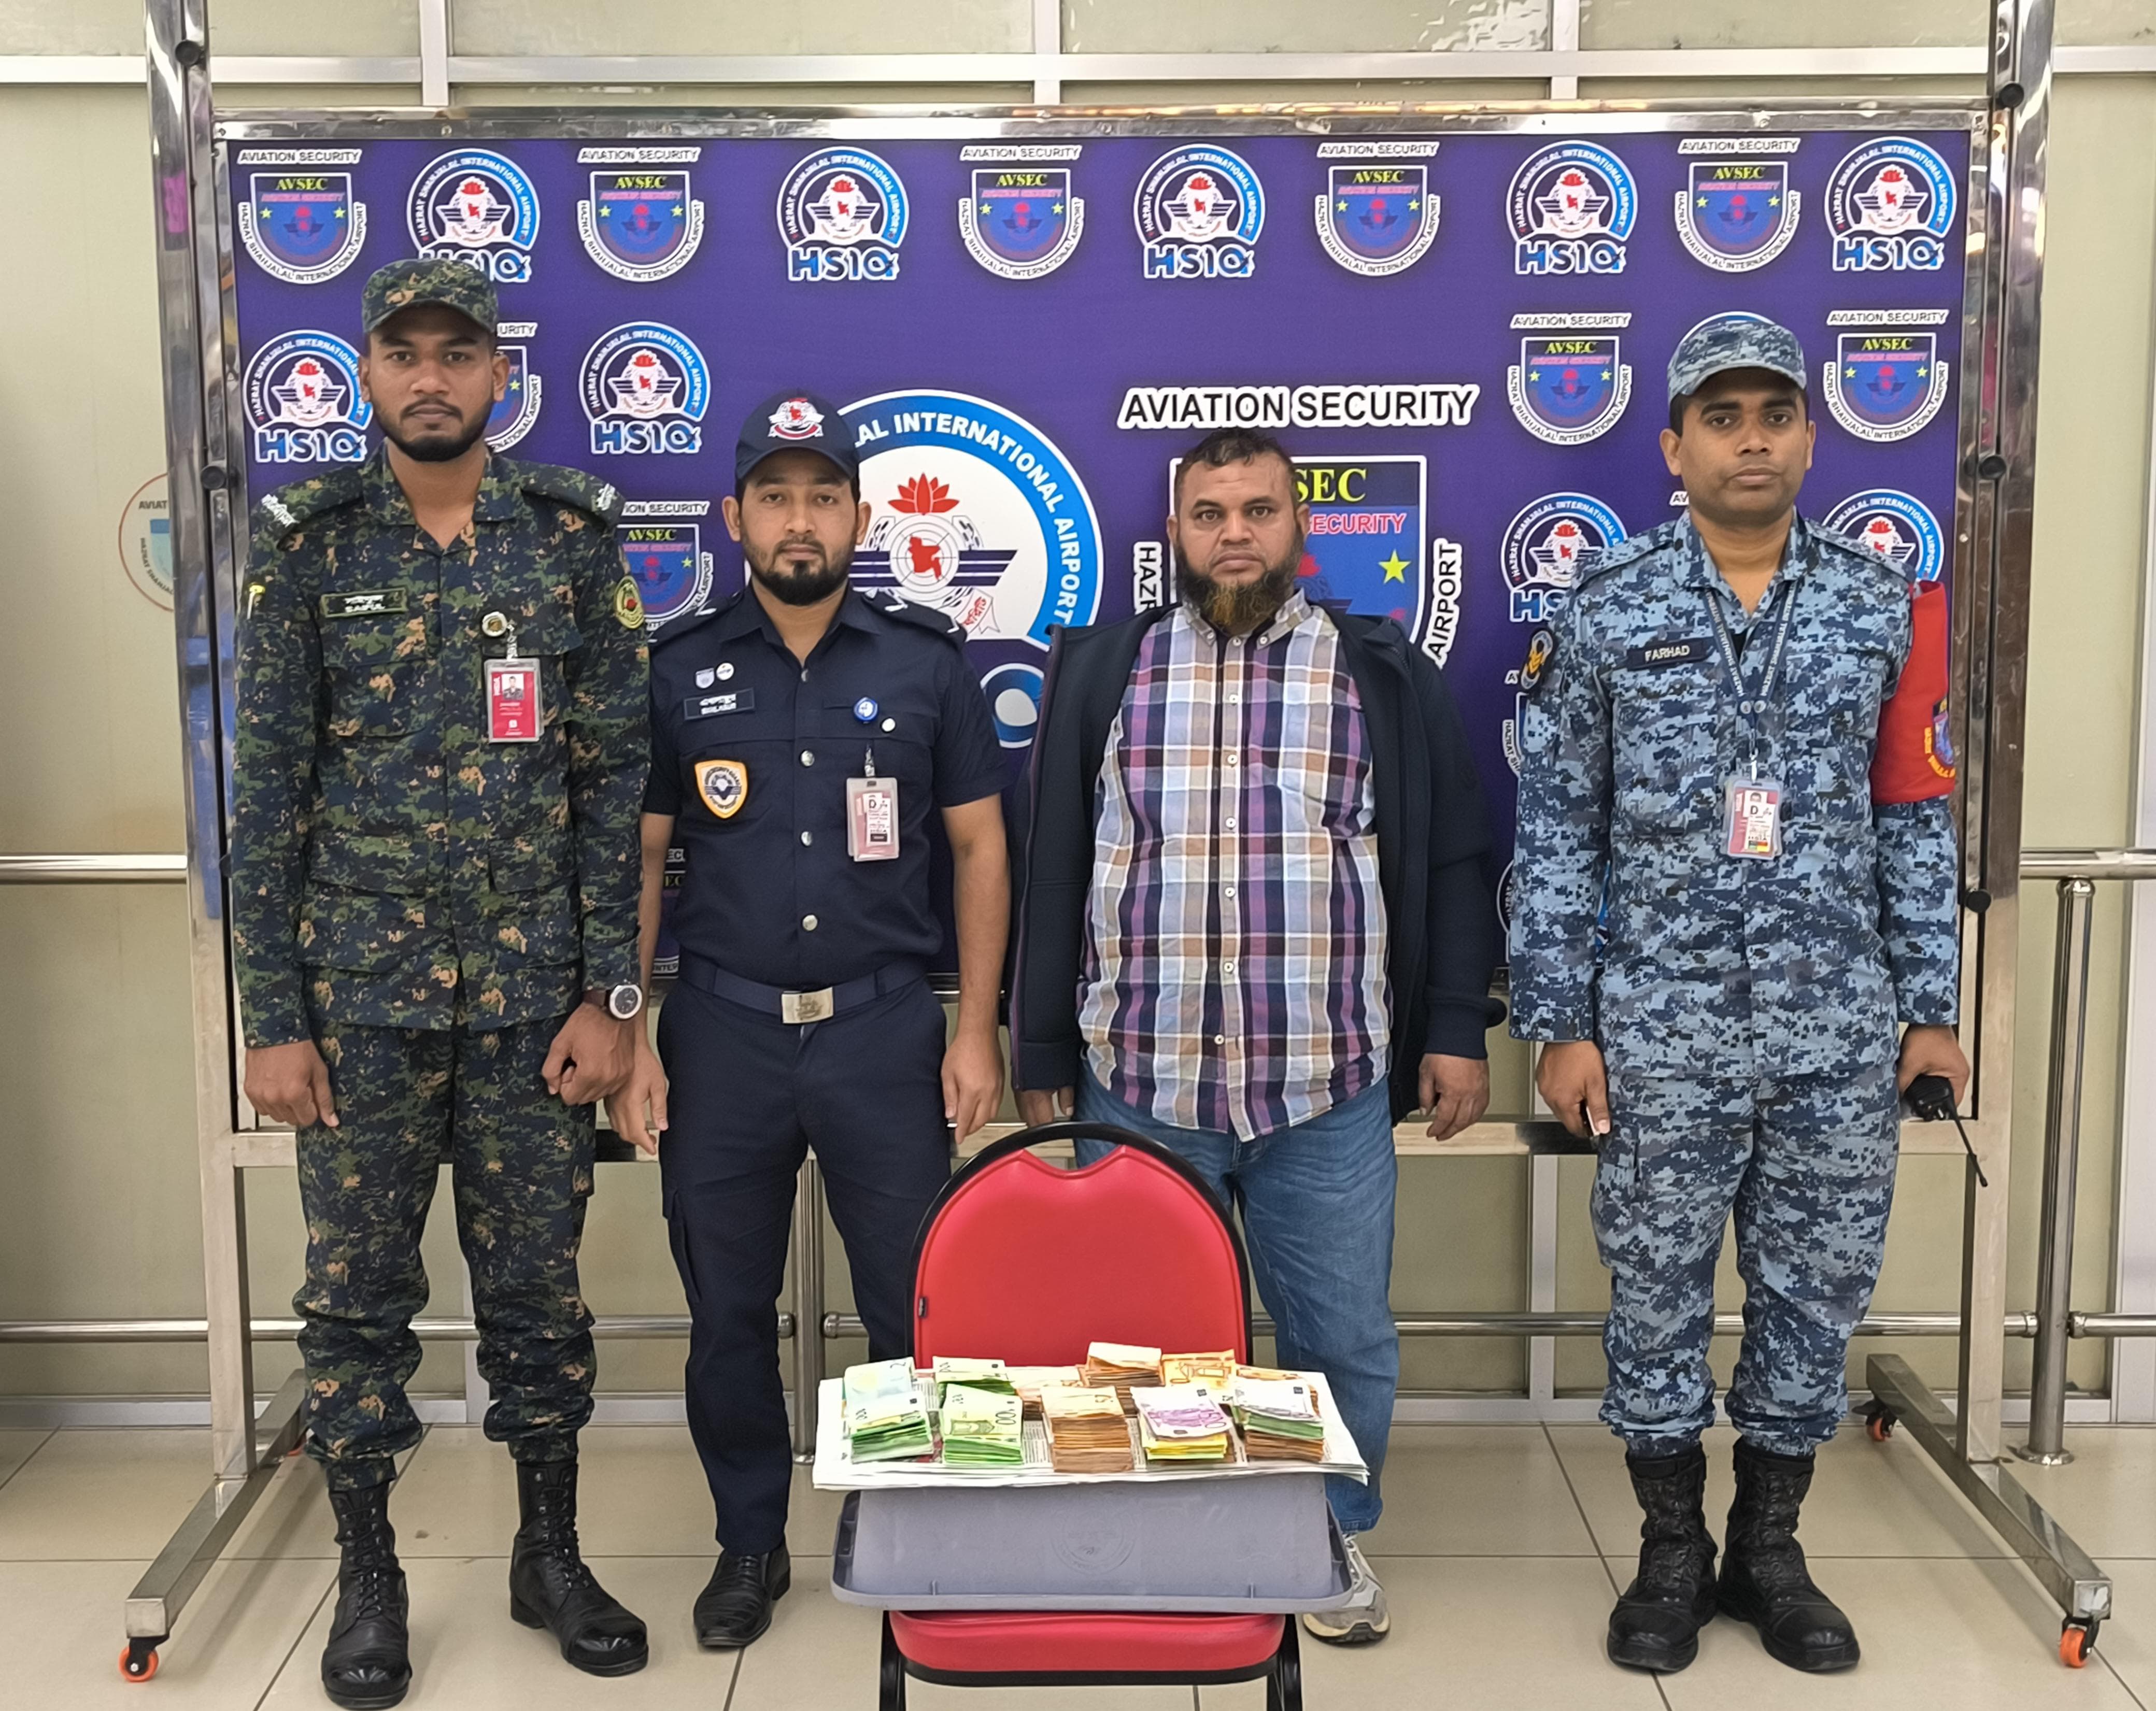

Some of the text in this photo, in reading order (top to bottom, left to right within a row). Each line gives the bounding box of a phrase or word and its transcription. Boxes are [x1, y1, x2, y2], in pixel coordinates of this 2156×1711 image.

[1320, 145, 1436, 154] AVIATION SECURITY
[1681, 141, 1796, 150] AVIATION SECURITY
[241, 151, 358, 161] AVIATION SECURITY
[581, 150, 698, 159] AVIATION SECURITY
[963, 148, 1079, 157] AVIATION SECURITY
[1353, 170, 1405, 183] AVSEC
[1713, 167, 1766, 180] AVSEC
[276, 178, 328, 190] AVSEC
[615, 176, 667, 189] AVSEC
[996, 174, 1047, 187] AVSEC
[1513, 316, 1628, 325] AVIATION SECURITY
[1830, 312, 1946, 322] AVIATION SECURITY
[499, 325, 534, 335] URITY
[1545, 341, 1599, 354] AVSEC
[1861, 338, 1915, 351] AVSEC
[1125, 390, 1474, 423] AVIATION SECURITY
[1295, 468, 1367, 502] SEC
[139, 501, 167, 509] AVIAT
[649, 504, 707, 512] SECURITY
[894, 411, 1066, 514] INTERNATIONAL
[1053, 517, 1081, 625] AIRPORT
[1310, 513, 1407, 535] ECURITY
[626, 529, 677, 541] AVSEC
[147, 569, 174, 595] SHAHJAL
[1138, 547, 1157, 610] HAZR
[1426, 544, 1457, 659] AIRPORT
[1645, 645, 1690, 662] FARHAD
[1750, 805, 1758, 815] D
